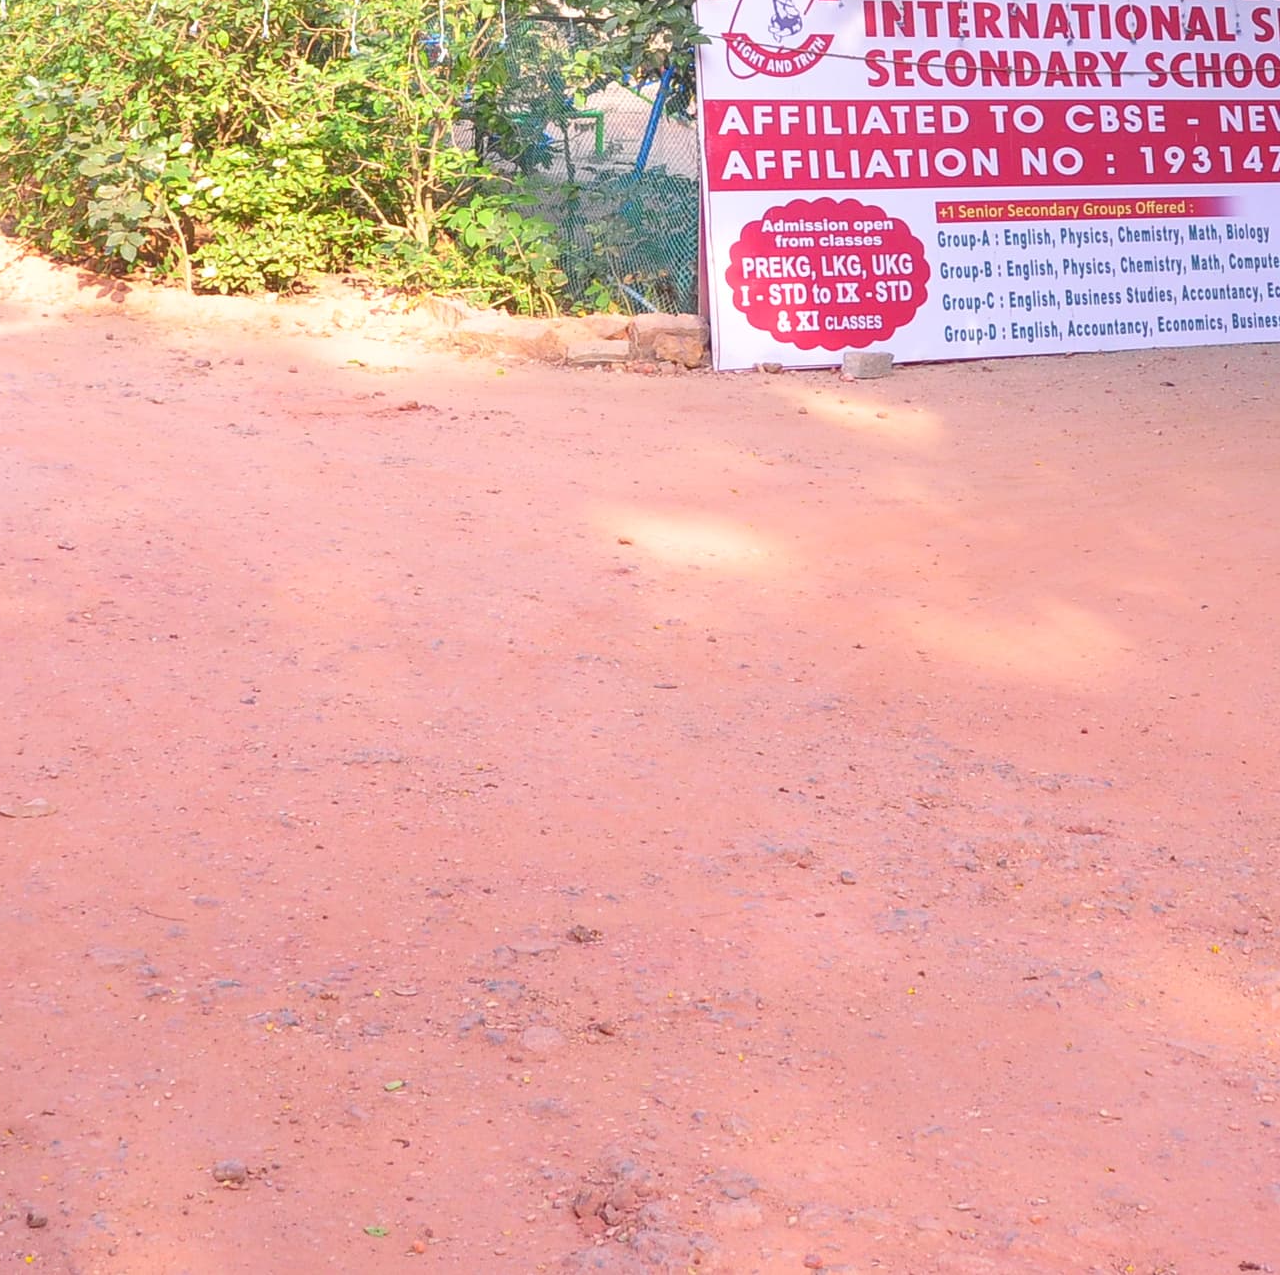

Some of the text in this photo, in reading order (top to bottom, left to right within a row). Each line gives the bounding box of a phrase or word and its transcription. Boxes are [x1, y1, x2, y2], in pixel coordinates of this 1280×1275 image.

[863, 0, 1236, 42] INTERNATIONAL
[732, 36, 826, 73] LIGHT AND TRUTH
[865, 49, 1128, 87] SECONDARY
[719, 104, 970, 135] AFFILIATED
[989, 104, 1044, 134] TO
[1065, 104, 1166, 133] CBSE
[721, 147, 999, 180] AFFILIATION
[1022, 146, 1083, 176] NO
[939, 204, 953, 218] +1
[959, 203, 1003, 218] Senior
[1007, 202, 1079, 220] Secondary
[1083, 202, 1131, 219] Groups
[1135, 200, 1185, 214] Offered
[762, 219, 894, 233] Admission open
[937, 228, 990, 250] Group-A
[1004, 227, 1056, 250] English,
[1060, 226, 1113, 249] Physics,
[1118, 225, 1184, 245] Chemistry,
[1188, 224, 1222, 244] Math,
[1226, 223, 1270, 243] Biology
[775, 234, 883, 248] from classes
[741, 253, 913, 280] PREKG, LKG, UKG
[940, 260, 993, 282] Group-B
[1007, 258, 1058, 281] English,
[1063, 257, 1116, 280] Physics,
[1120, 255, 1187, 276] Chemistry,
[1191, 254, 1224, 273] Math,
[769, 283, 807, 305] STD
[812, 284, 831, 304] to
[836, 282, 860, 303] IX
[942, 291, 995, 312] Group-C
[1009, 289, 1061, 312] English,
[1065, 288, 1121, 306] Business
[1126, 285, 1177, 305] Studies,
[1182, 283, 1263, 303] Accountancy,
[777, 310, 883, 332] & XI CLASSES
[944, 323, 997, 345] Group-D
[1011, 320, 1063, 343] English,
[1068, 318, 1153, 338] Accountancy,
[1157, 314, 1227, 333] Economics,
